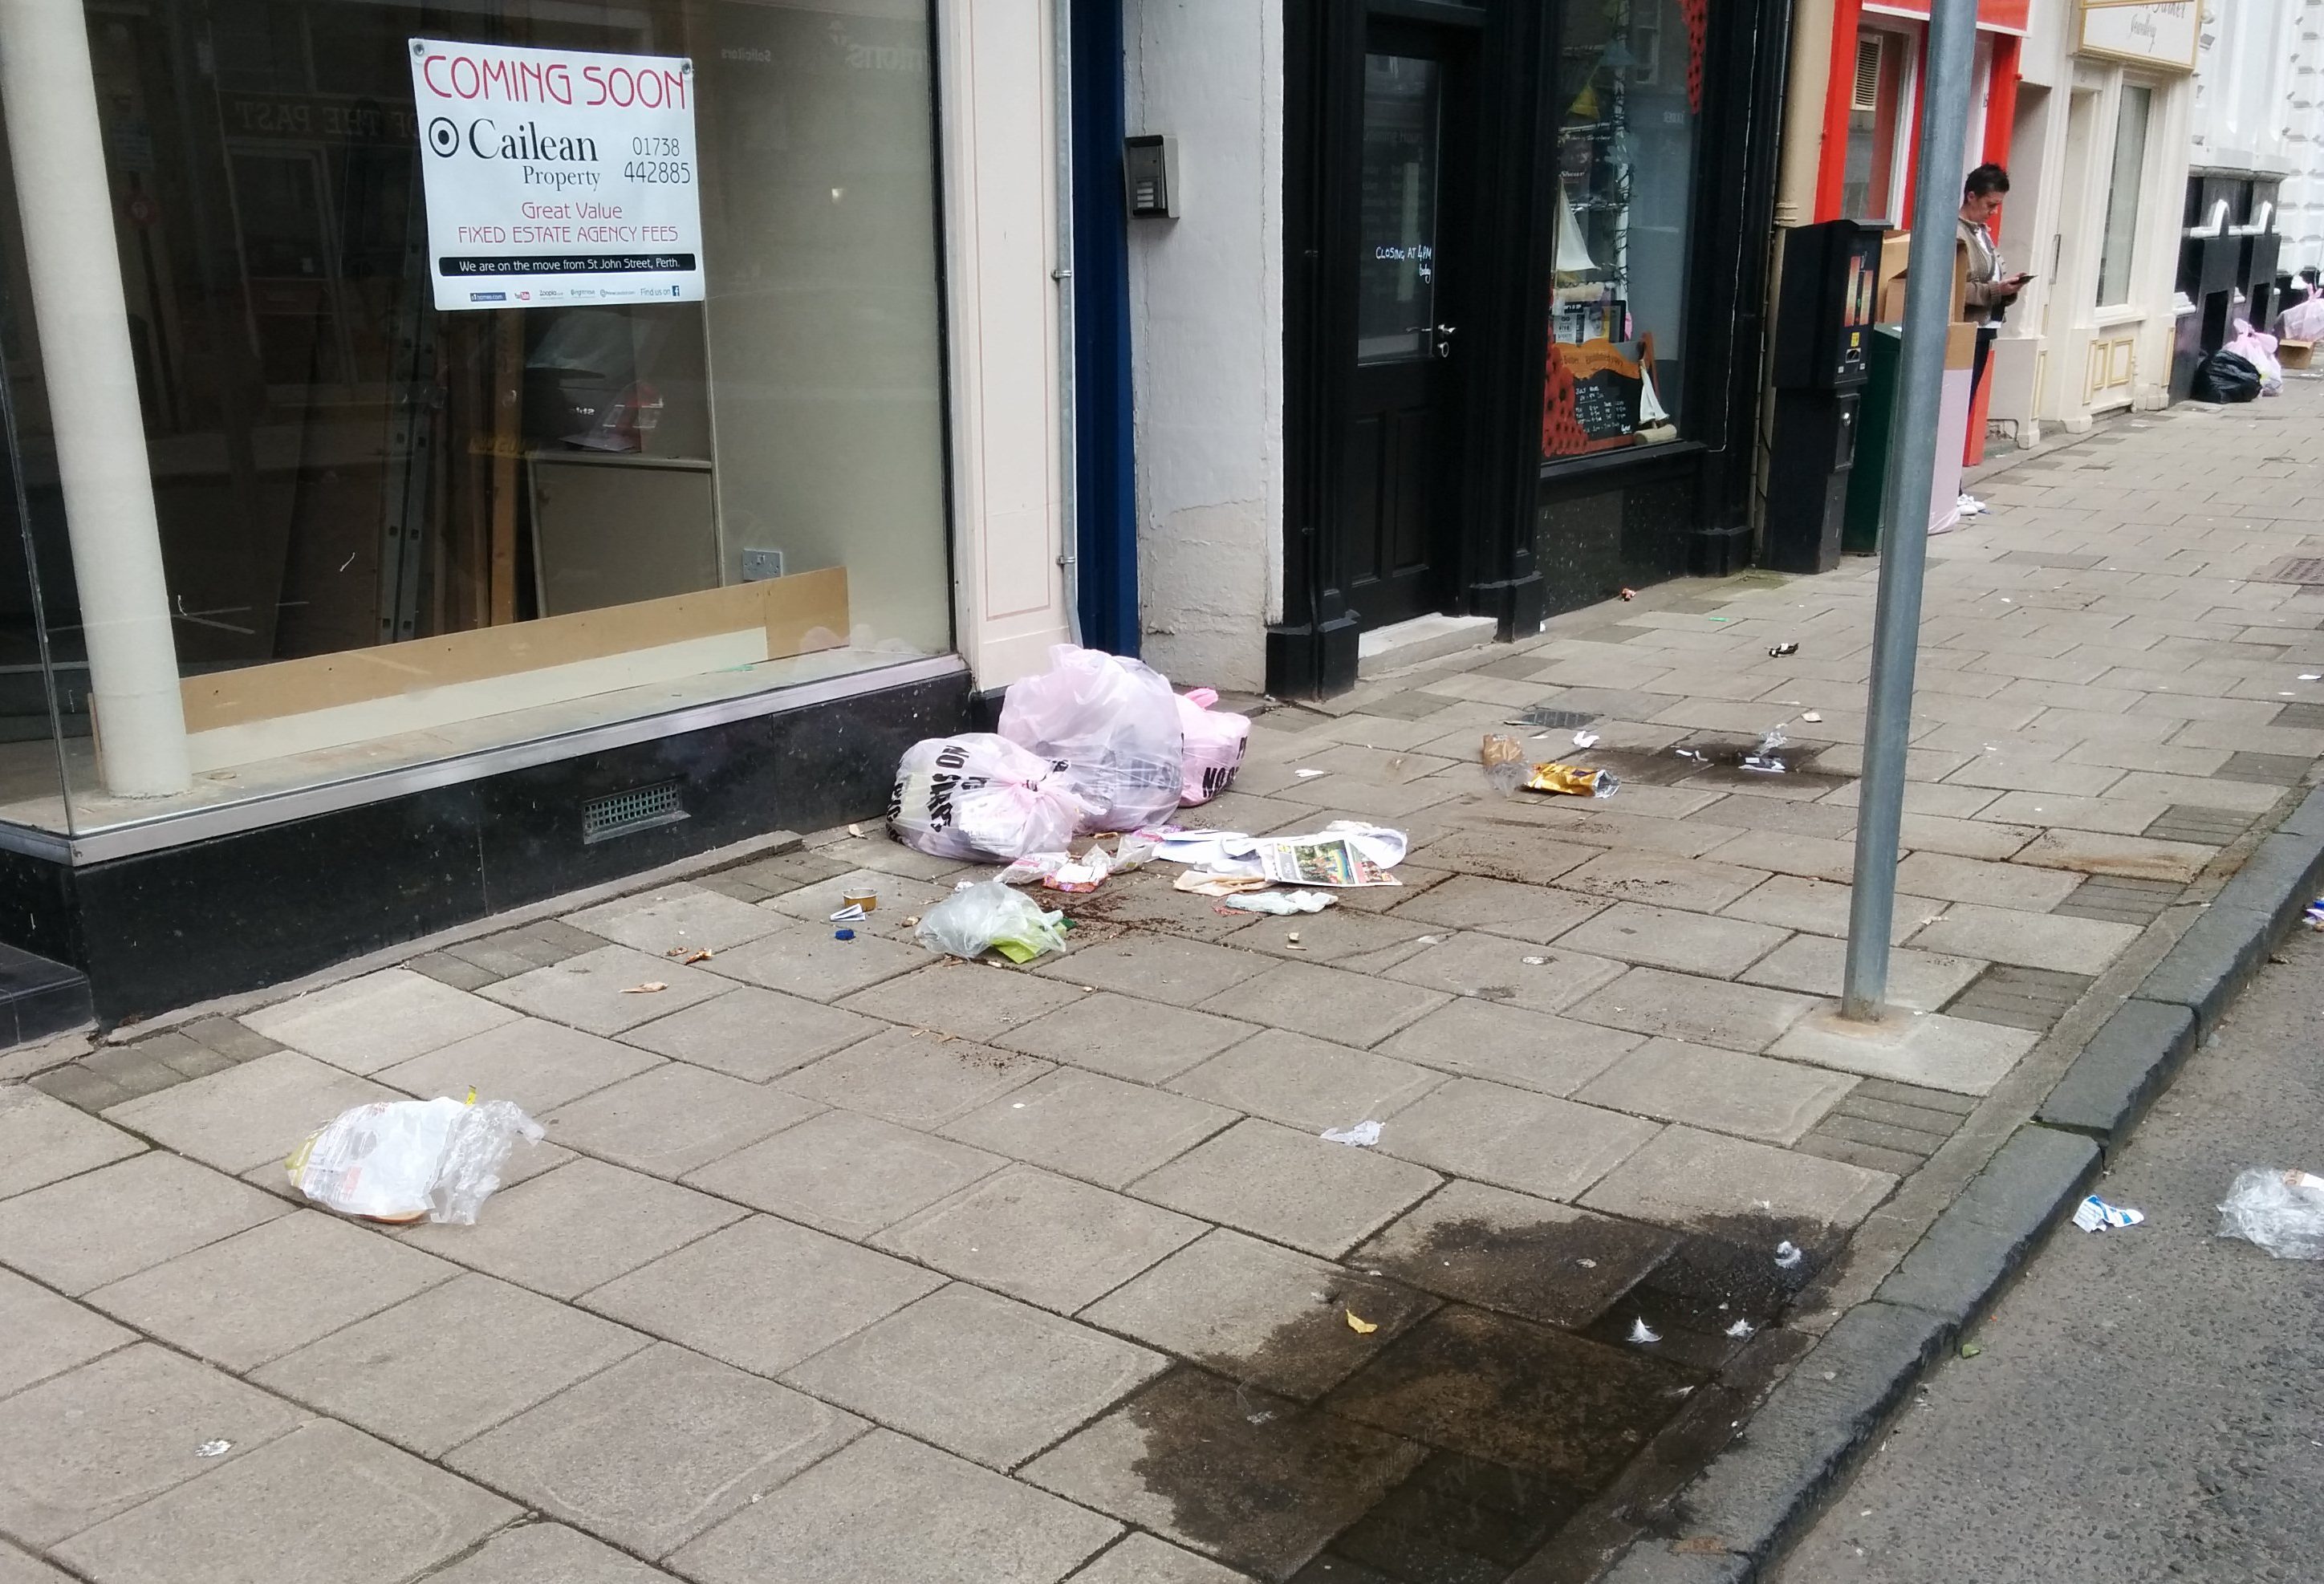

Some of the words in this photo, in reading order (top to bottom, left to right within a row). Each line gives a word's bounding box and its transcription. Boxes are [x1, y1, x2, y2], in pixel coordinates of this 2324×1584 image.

[424, 55, 572, 105] COMING
[583, 66, 685, 109] SOON
[469, 118, 599, 161] Cailean
[632, 137, 680, 156] 01738
[523, 165, 601, 192] Property
[624, 161, 690, 184] 442885
[522, 201, 571, 219] Great
[575, 202, 623, 219] Value
[458, 226, 506, 243] FIXED
[513, 226, 571, 243] ESTATE
[577, 226, 637, 242] AGENCY
[642, 226, 678, 242] FEES
[1408, 246, 1417, 259] AT
[460, 261, 477, 271] We
[479, 262, 495, 271] are
[498, 262, 511, 270] on
[514, 260, 530, 270] the
[533, 262, 560, 270] move
[563, 259, 585, 270] from
[587, 259, 598, 269] St
[599, 258, 622, 269] John
[624, 258, 653, 270] Street,
[656, 258, 680, 268] Perth.
[936, 745, 970, 769] NO
